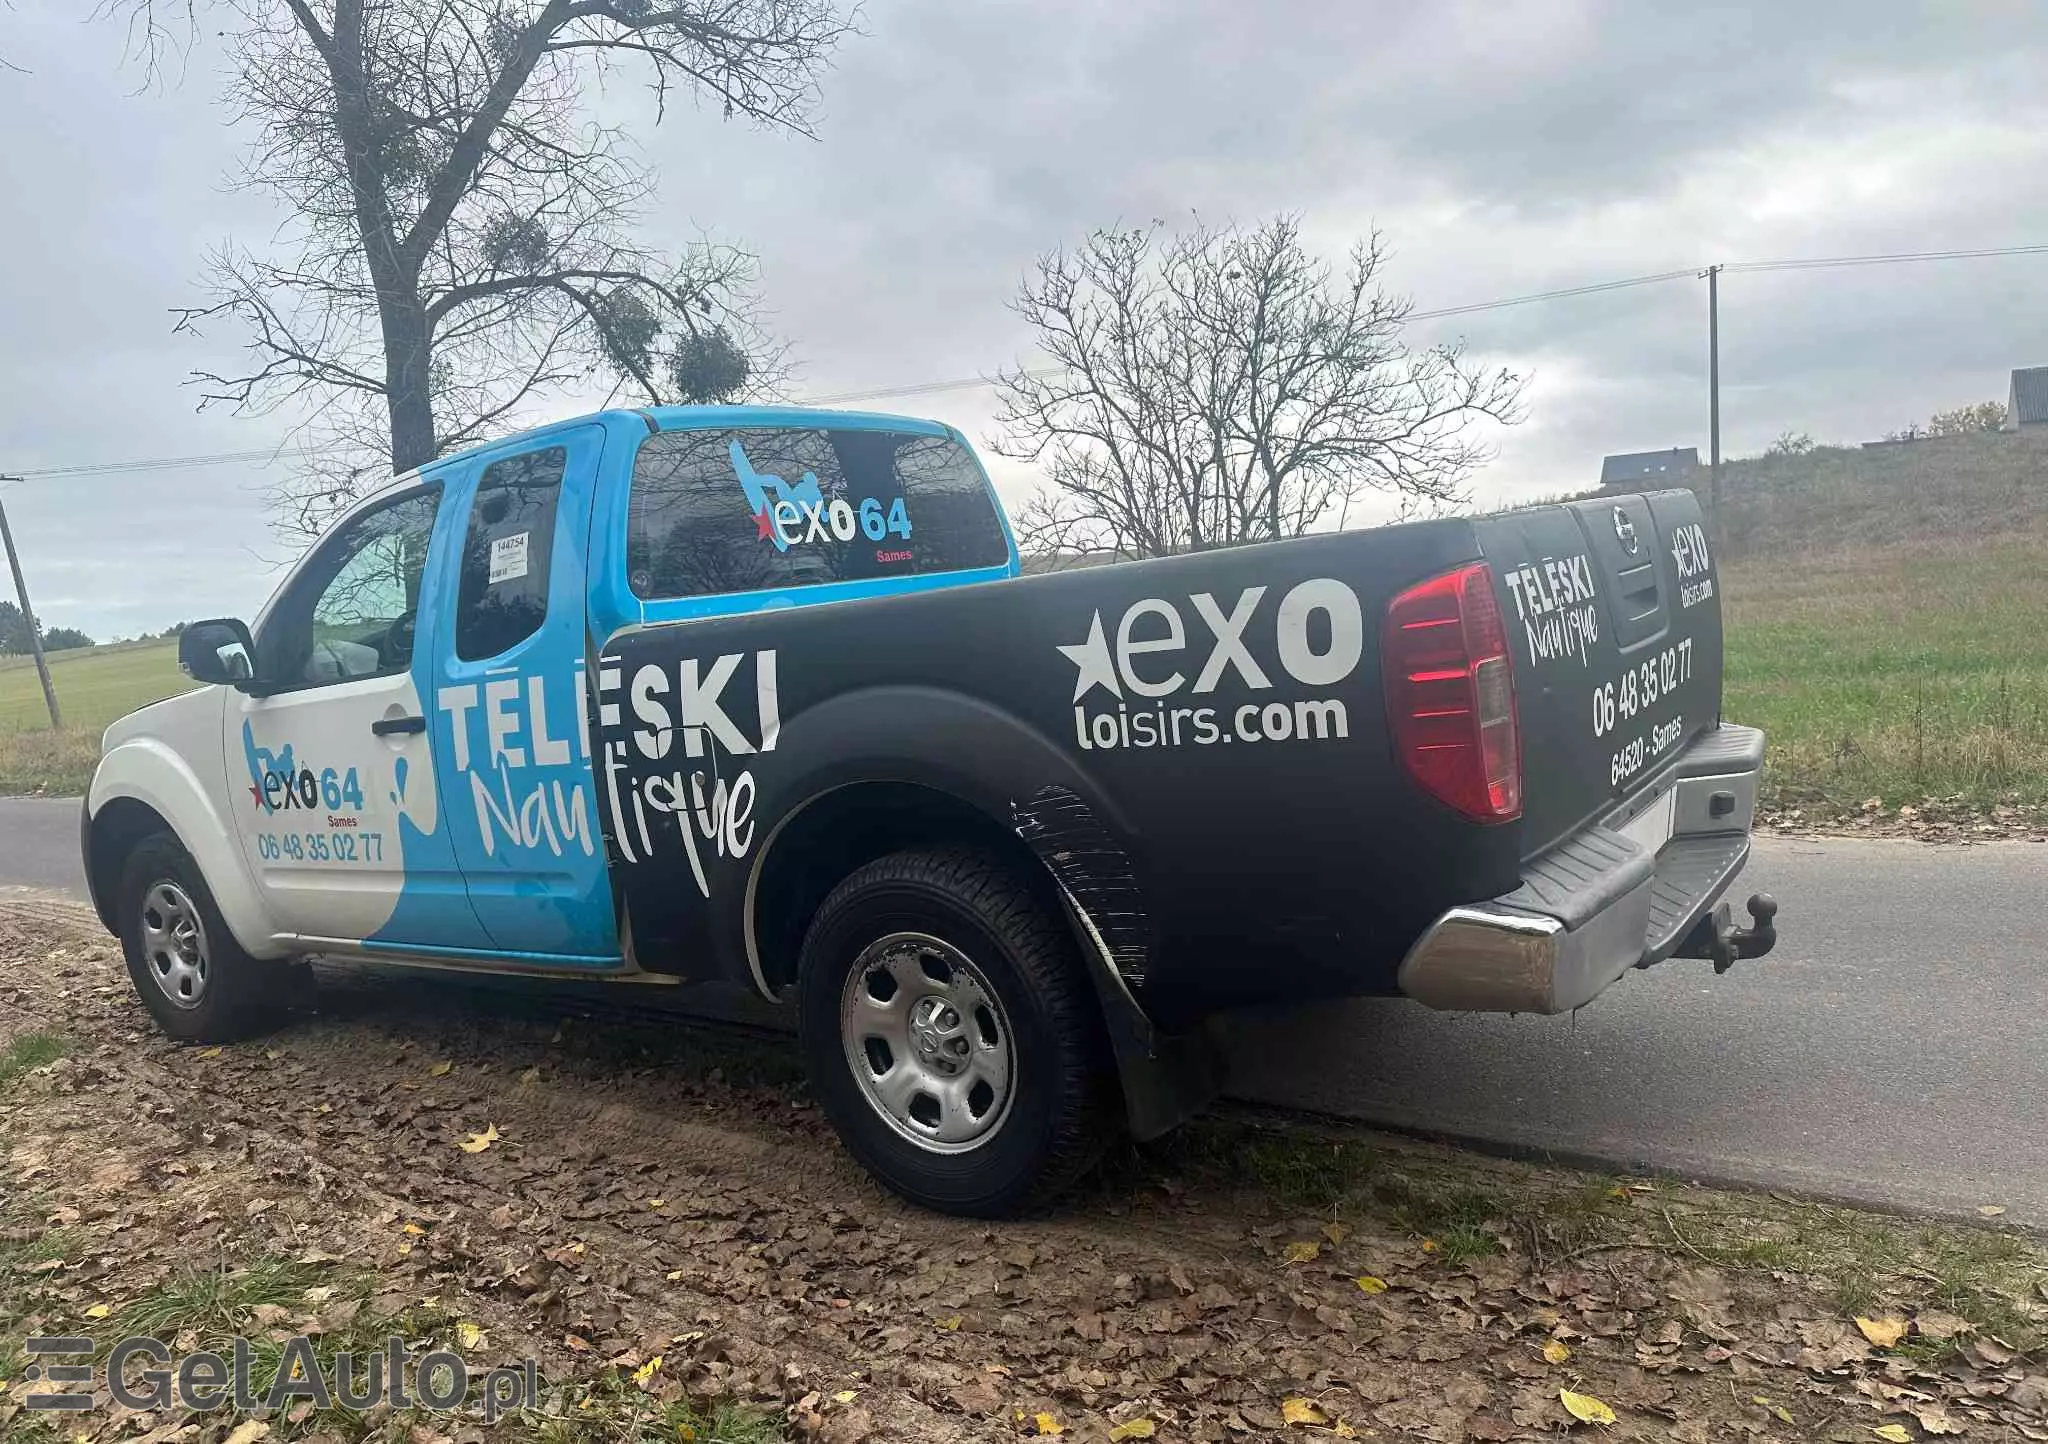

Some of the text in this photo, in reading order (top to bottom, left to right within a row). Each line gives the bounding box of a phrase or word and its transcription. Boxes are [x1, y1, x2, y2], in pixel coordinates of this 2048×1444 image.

[876, 550, 913, 562] Sames
[1676, 523, 1709, 577] exo
[1116, 578, 1363, 698] exo
[1592, 637, 1693, 737] 06 48 35 02 77
[1074, 698, 1349, 750] loisirs.com
[1611, 736, 1643, 786] 64520
[1652, 714, 1682, 756] Sames
[328, 815, 358, 827] Sames
[470, 741, 756, 899] Nautique
[258, 833, 383, 862] 06 48 35 02 77
